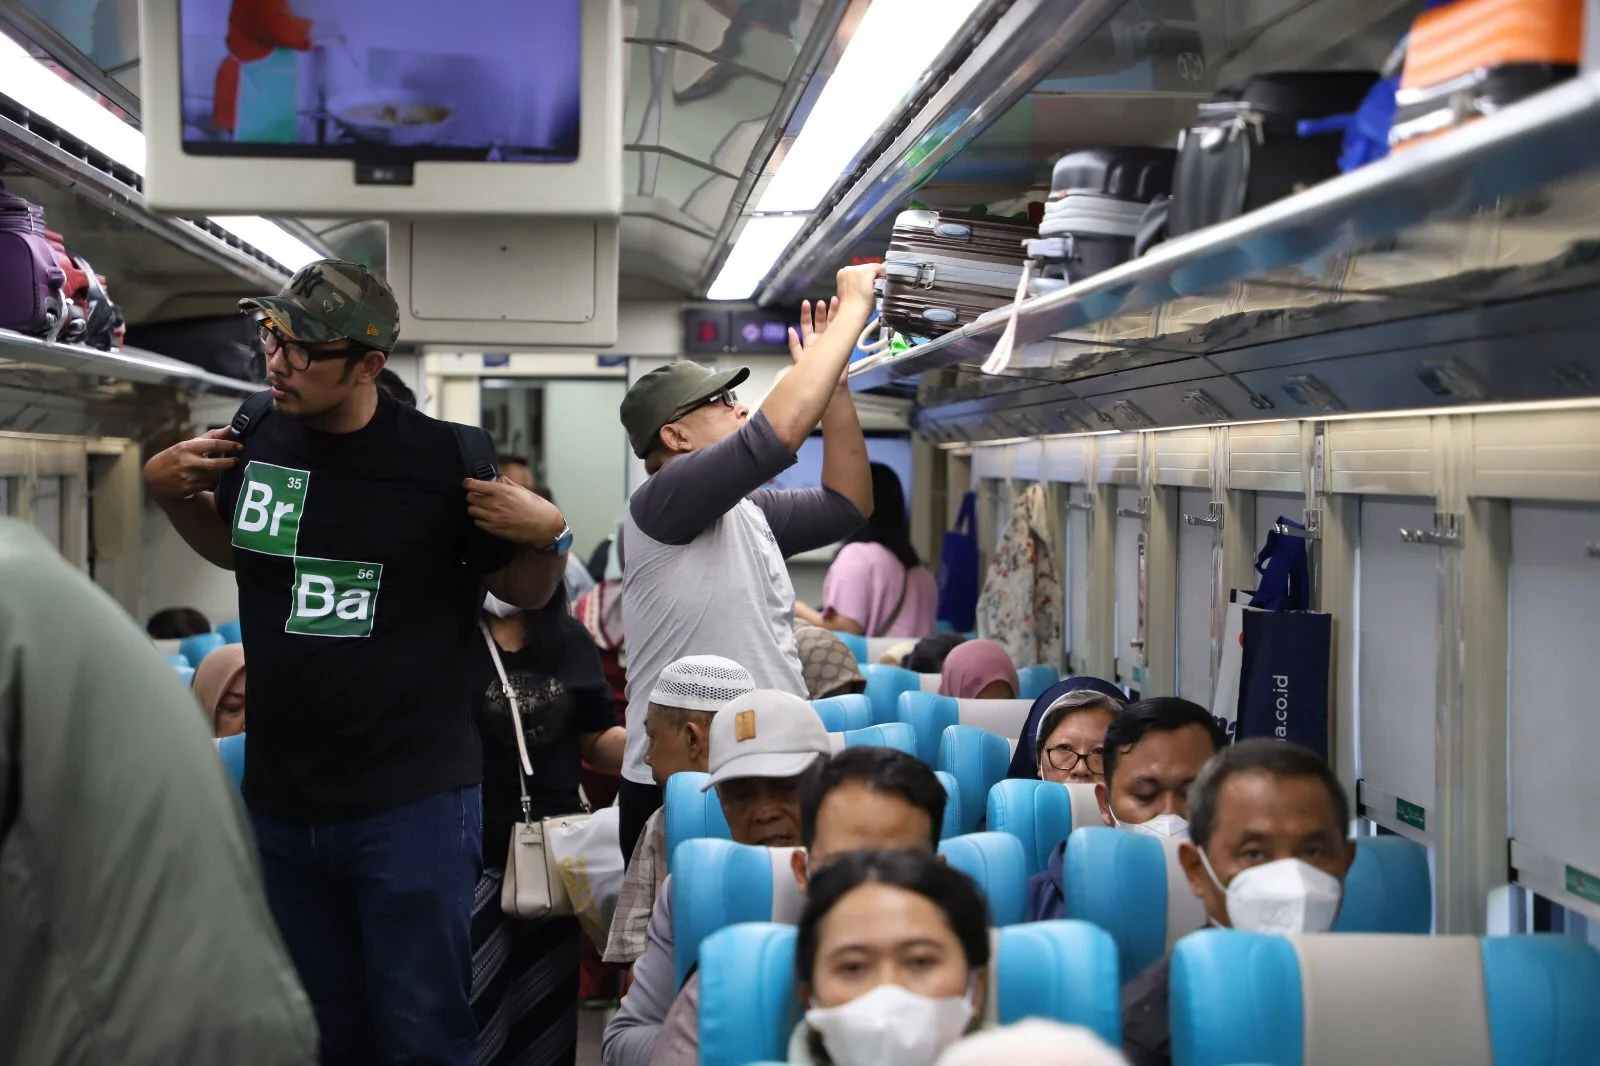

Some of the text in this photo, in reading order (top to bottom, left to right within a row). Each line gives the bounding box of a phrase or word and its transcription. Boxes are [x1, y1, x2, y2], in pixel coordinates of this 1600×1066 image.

[287, 476, 302, 490] 35
[237, 480, 294, 537] Br
[356, 569, 374, 580] 56
[296, 573, 371, 621] Ba
